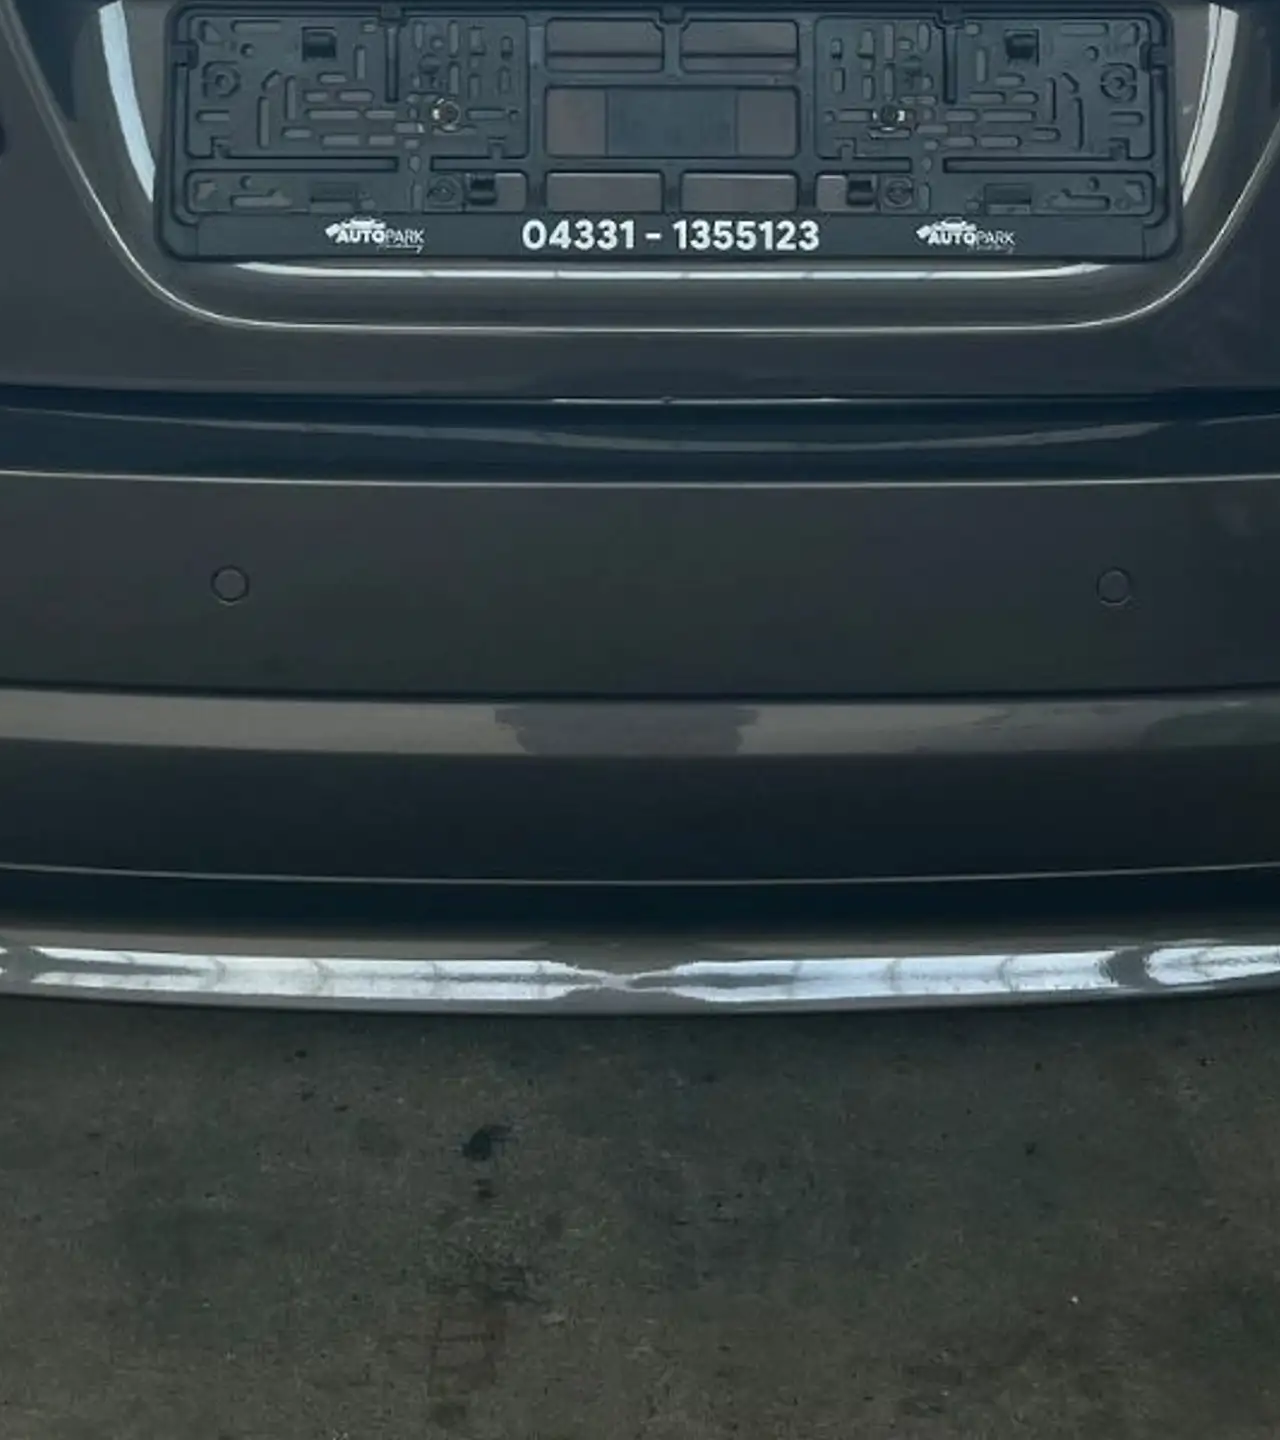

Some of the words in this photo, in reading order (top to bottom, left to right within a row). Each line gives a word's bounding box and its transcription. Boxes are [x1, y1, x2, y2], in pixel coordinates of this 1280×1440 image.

[335, 228, 425, 244] AUTOPARK
[522, 219, 635, 250] 04331
[672, 219, 820, 251] 1355123
